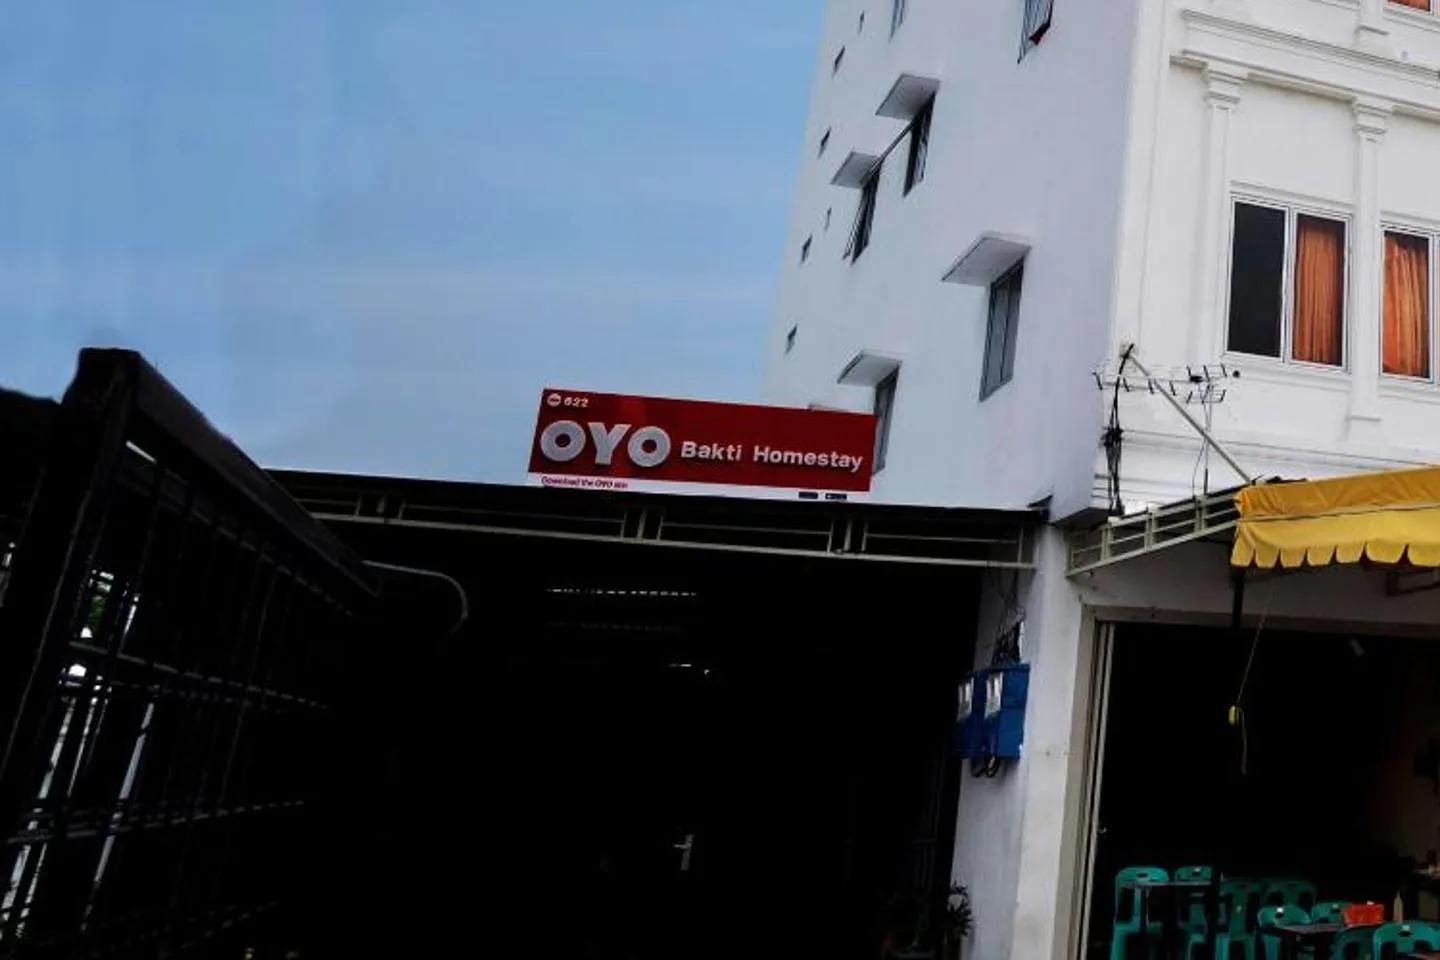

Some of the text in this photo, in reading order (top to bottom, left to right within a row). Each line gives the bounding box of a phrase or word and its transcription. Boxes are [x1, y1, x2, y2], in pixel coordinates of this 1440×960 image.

[540, 420, 863, 472] OYO Bakti Homestay
